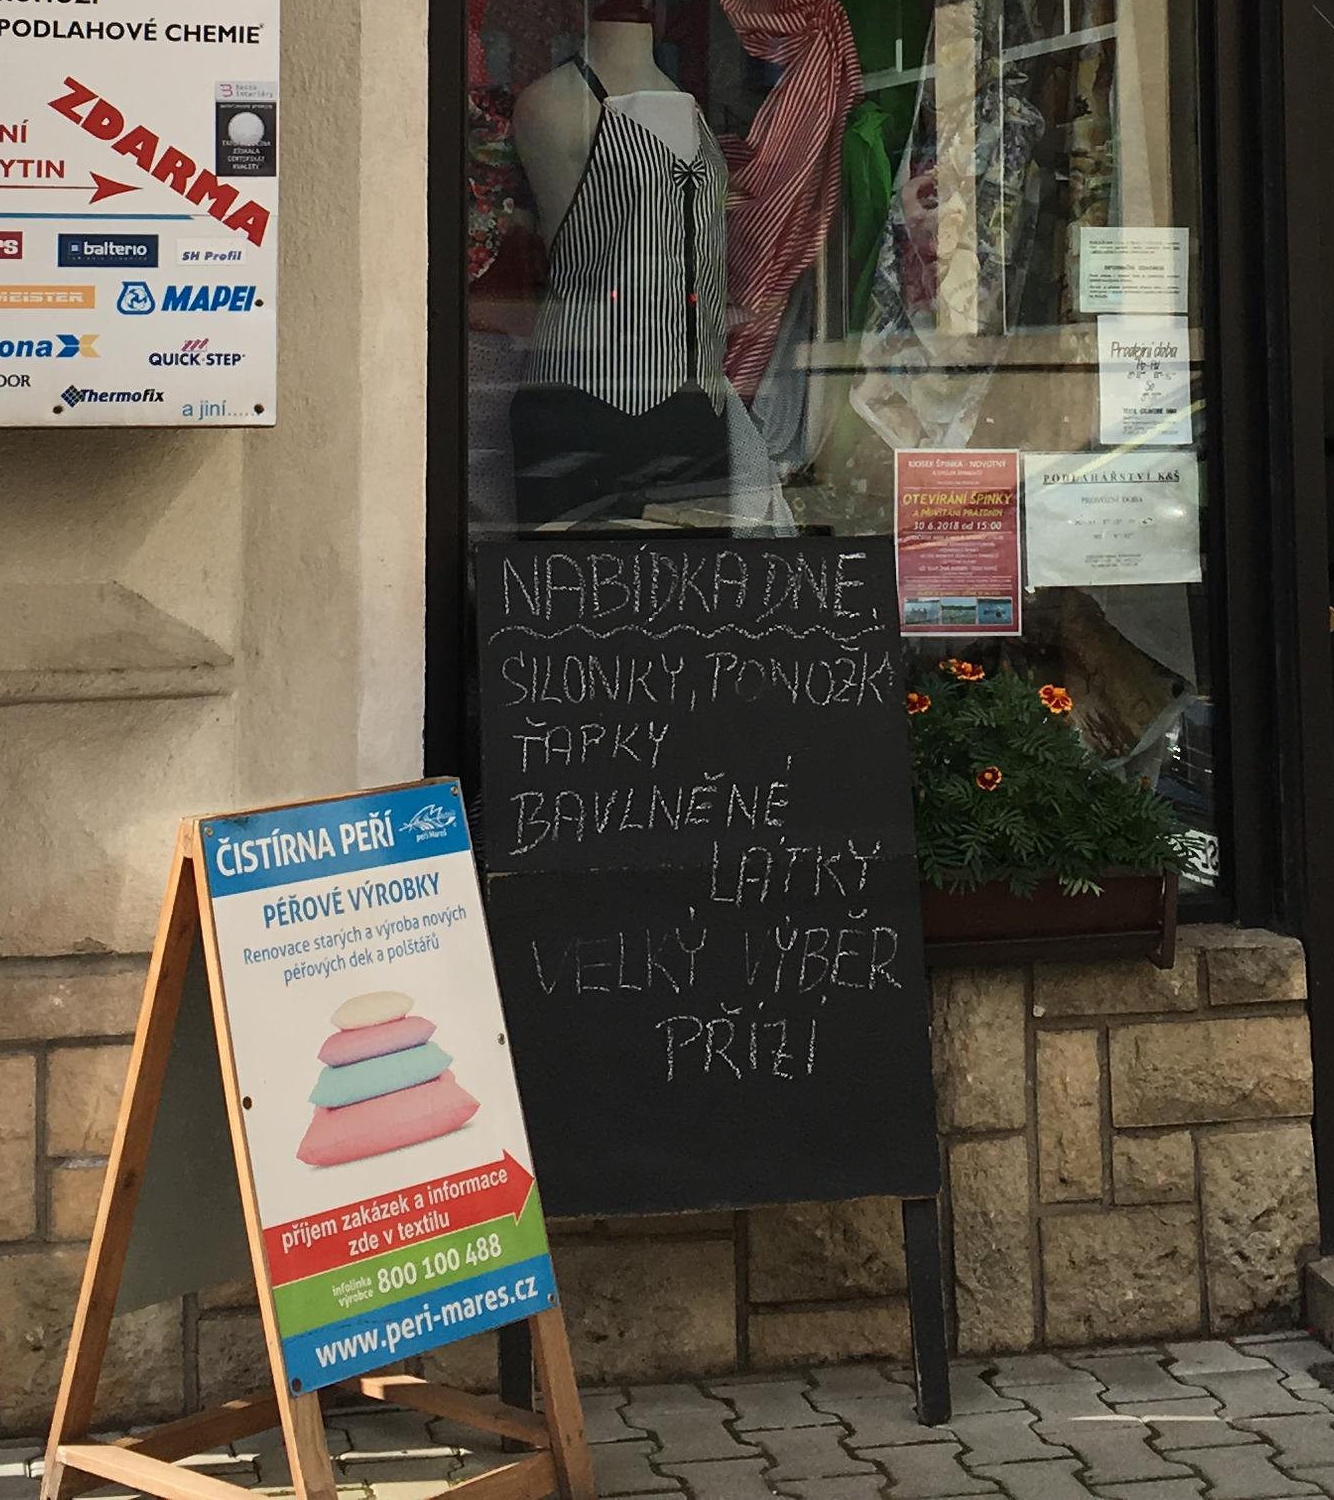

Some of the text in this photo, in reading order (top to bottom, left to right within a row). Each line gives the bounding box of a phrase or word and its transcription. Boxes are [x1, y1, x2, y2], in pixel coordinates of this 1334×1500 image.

[164, 23, 260, 45] CHEMIE
[47, 75, 271, 248] ZDARMA
[83, 240, 148, 256] balterio
[181, 250, 242, 261] SH Profil
[160, 285, 257, 312] MAPEI
[80, 388, 165, 403] Thermofix
[181, 403, 194, 417] a
[502, 543, 750, 624] NABÍDKA
[508, 754, 793, 856] BAVLNĚNÉ
[215, 807, 396, 877] ČISTÍRNA PEŘÍ
[709, 835, 882, 907] LÁTKY
[262, 872, 440, 929] PÉŘOVÉ VÝROBKY
[243, 903, 468, 965] Renovace starých a výroba nových
[282, 931, 440, 987] péřových dek a polštářů
[281, 1167, 509, 1254] příjem zakázek a informace
[348, 1209, 451, 1257] zde v textilu
[377, 1262, 418, 1295] 800
[421, 1249, 461, 1281] 100
[465, 1232, 503, 1268] 488
[315, 1272, 539, 1370] www.peri-mares.cz
